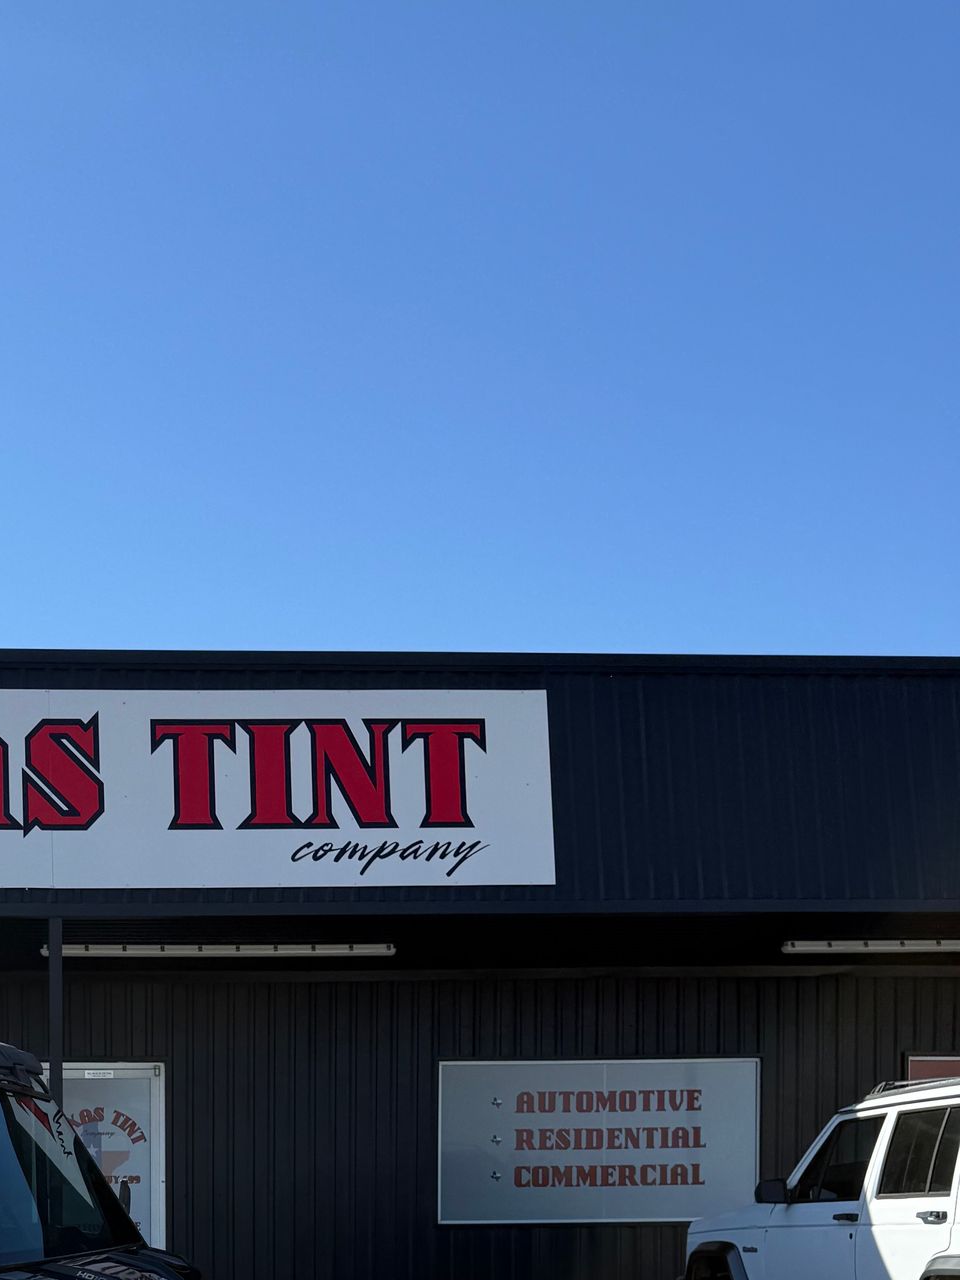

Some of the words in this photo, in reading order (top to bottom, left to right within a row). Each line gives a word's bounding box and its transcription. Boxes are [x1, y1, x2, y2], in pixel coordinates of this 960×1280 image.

[150, 718, 486, 830] TINT
[290, 838, 489, 877] company
[515, 1089, 702, 1113] AUTOMOTIVE
[112, 1110, 146, 1144] TINT
[514, 1126, 706, 1150] RESIDENTIAL
[513, 1163, 705, 1187] COMMERCIAL
